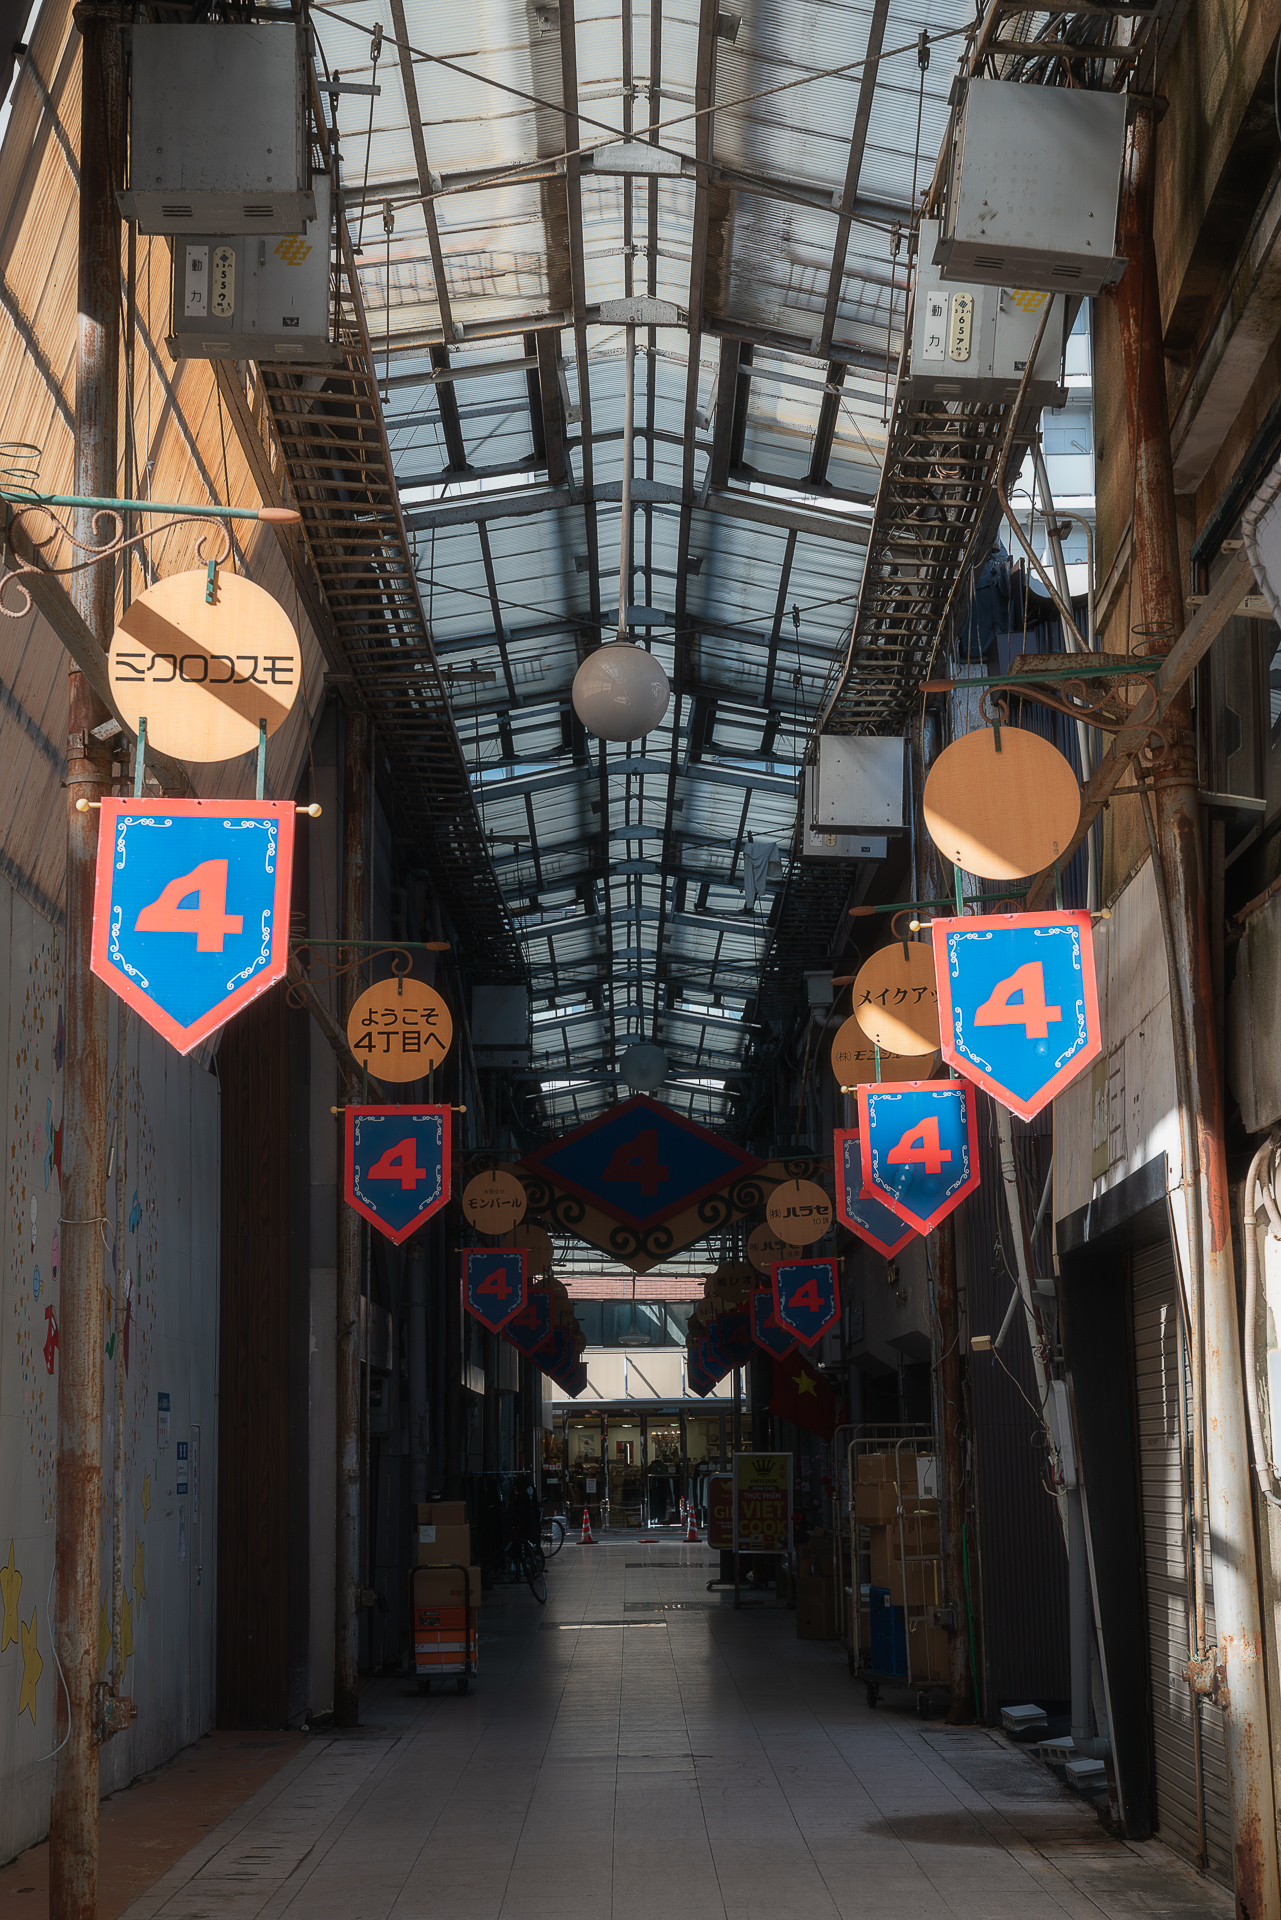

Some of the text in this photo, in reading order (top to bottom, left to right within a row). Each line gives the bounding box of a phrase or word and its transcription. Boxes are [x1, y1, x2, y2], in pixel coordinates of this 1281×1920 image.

[191, 259, 203, 303] 動力
[929, 304, 943, 347] 動力
[956, 316, 965, 345] 65ア
[135, 859, 243, 952] 4
[974, 961, 1061, 1038] 4
[361, 1007, 439, 1027] ようこそ
[353, 1030, 447, 1053] 4丁目へ
[887, 1116, 952, 1174] 4
[367, 1138, 426, 1189] 4
[601, 1128, 670, 1198] 4
[467, 1197, 522, 1209] モンバール
[477, 1268, 512, 1299] 4
[788, 1279, 825, 1312] 4
[512, 1304, 542, 1331] 4
[536, 1337, 560, 1357] 4
[727, 1324, 751, 1346] 4
[741, 1501, 785, 1518] VIET
[738, 1519, 787, 1535] COOK
